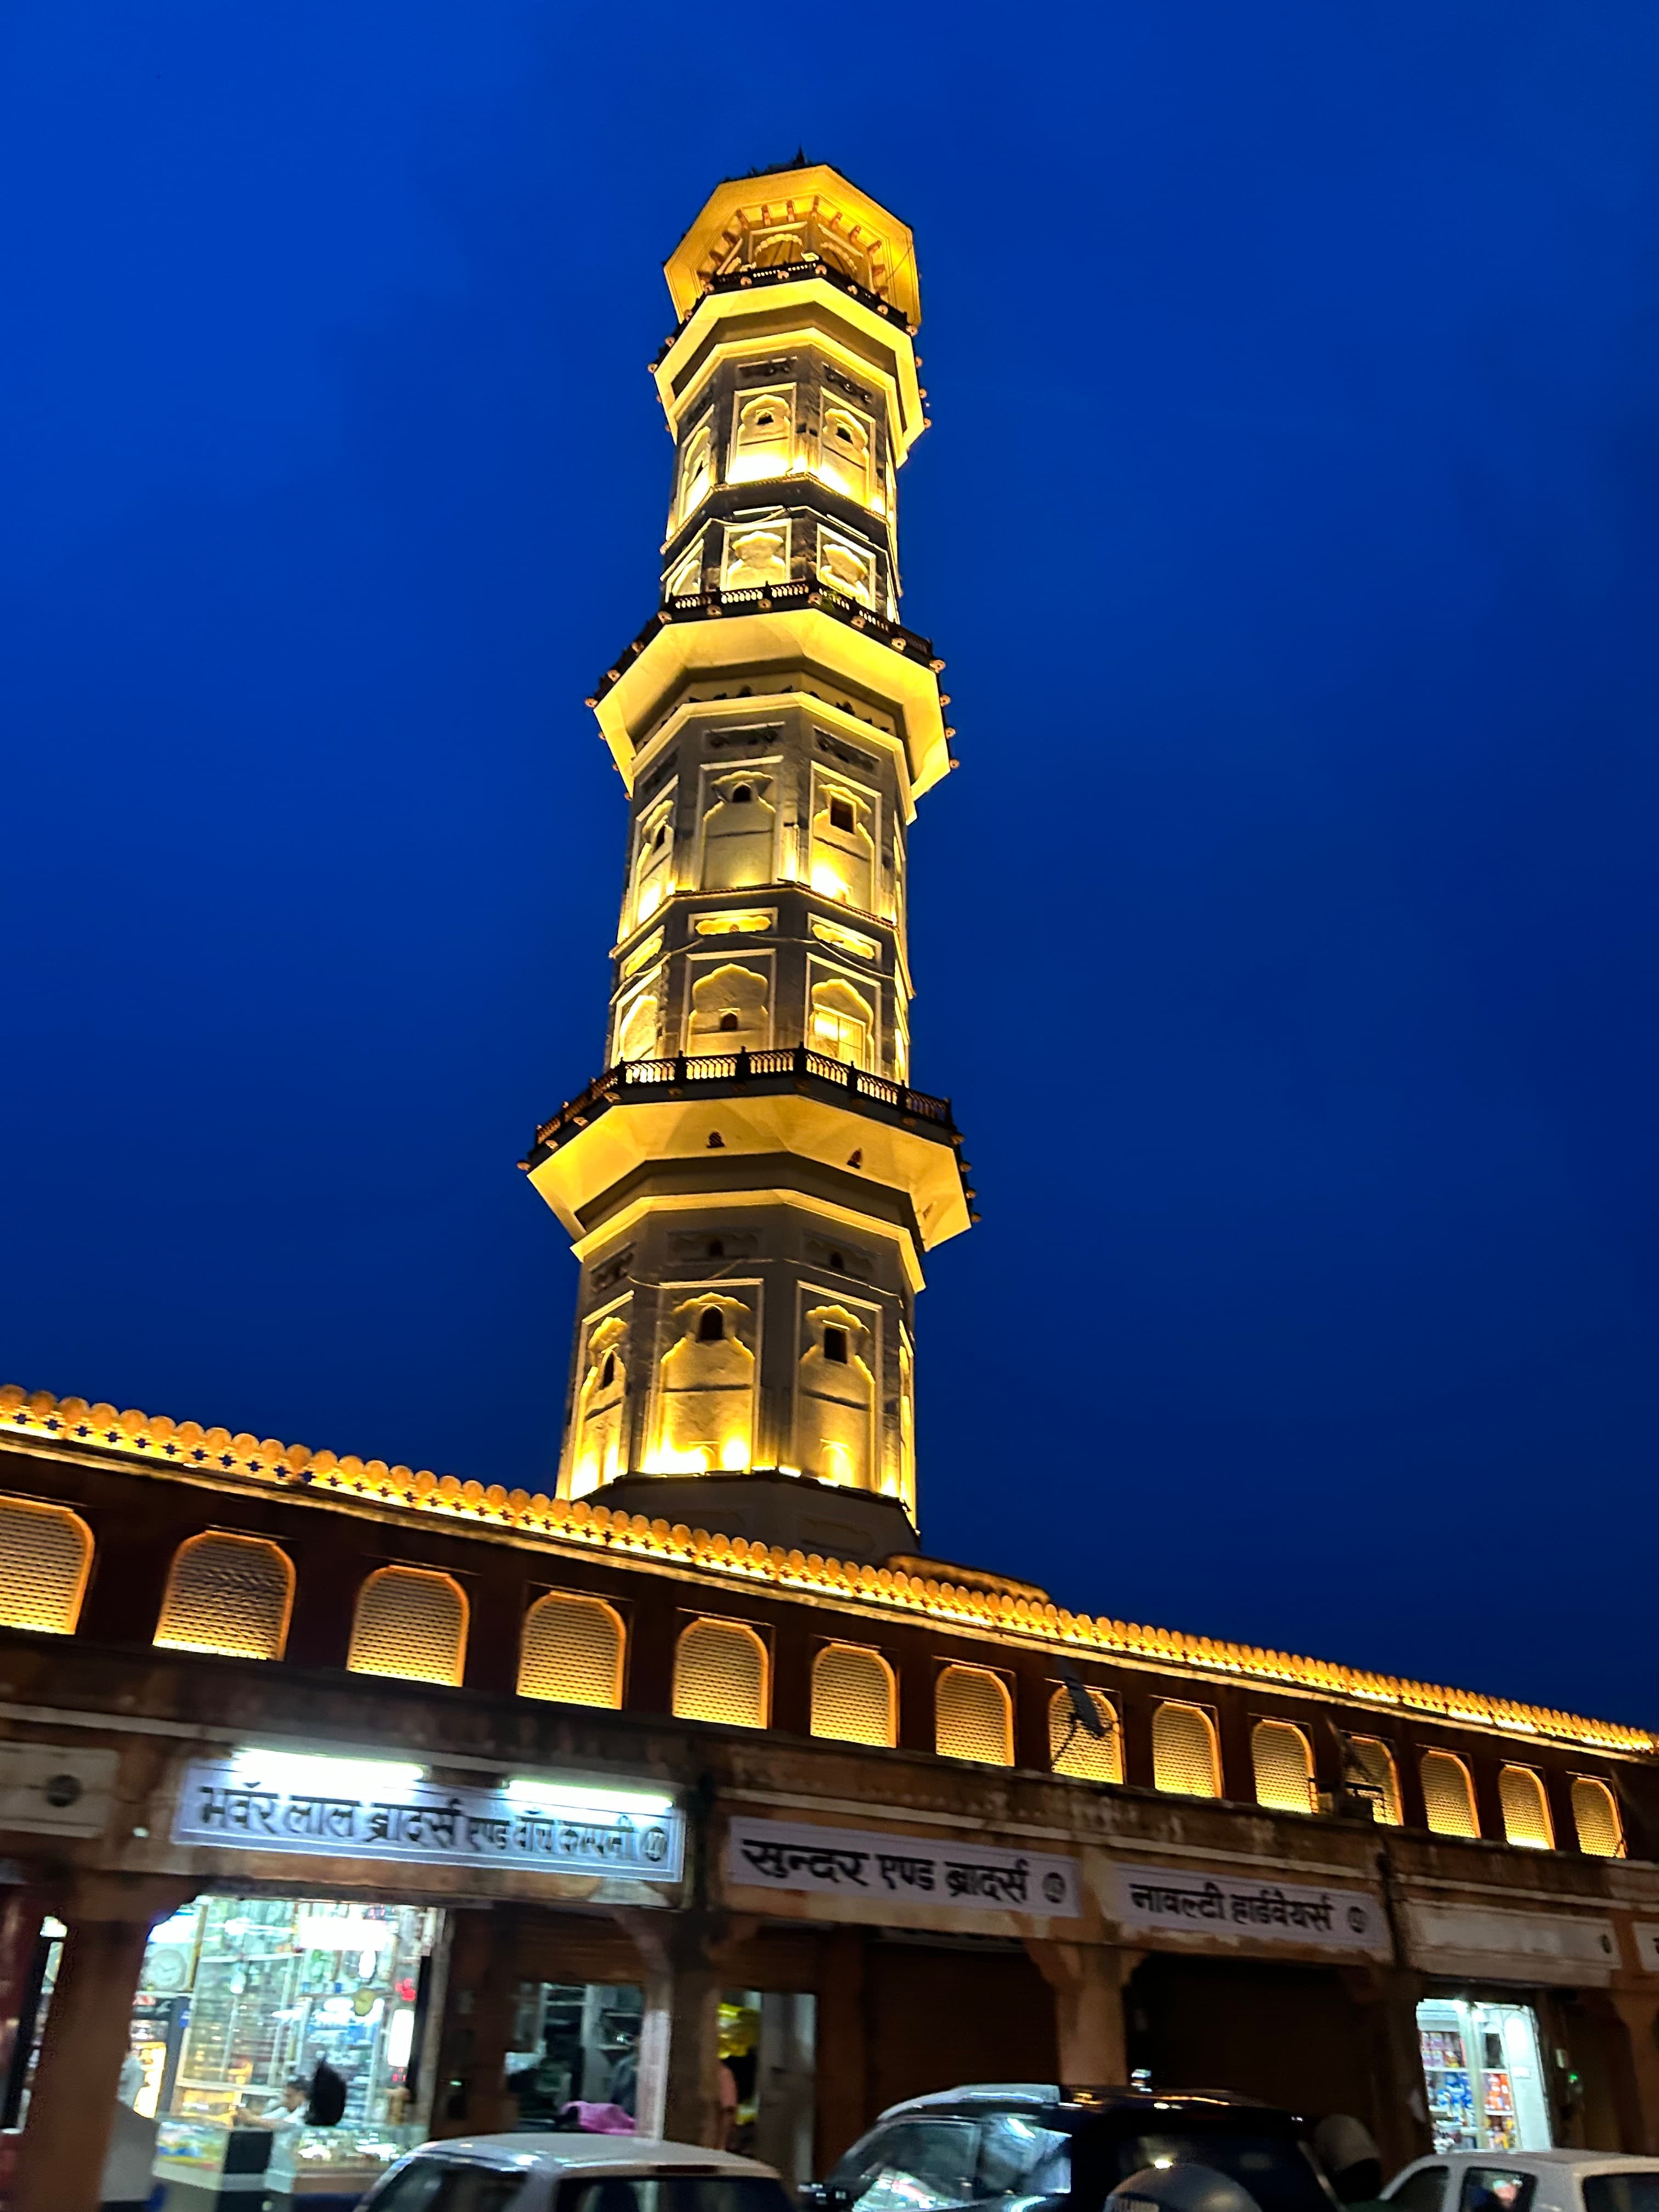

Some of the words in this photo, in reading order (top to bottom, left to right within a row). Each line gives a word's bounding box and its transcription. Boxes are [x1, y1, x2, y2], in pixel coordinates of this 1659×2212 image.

[284, 1795, 363, 1836] लाल
[741, 1838, 870, 1887] सुन्दर
[875, 1853, 936, 1891] एण्ड
